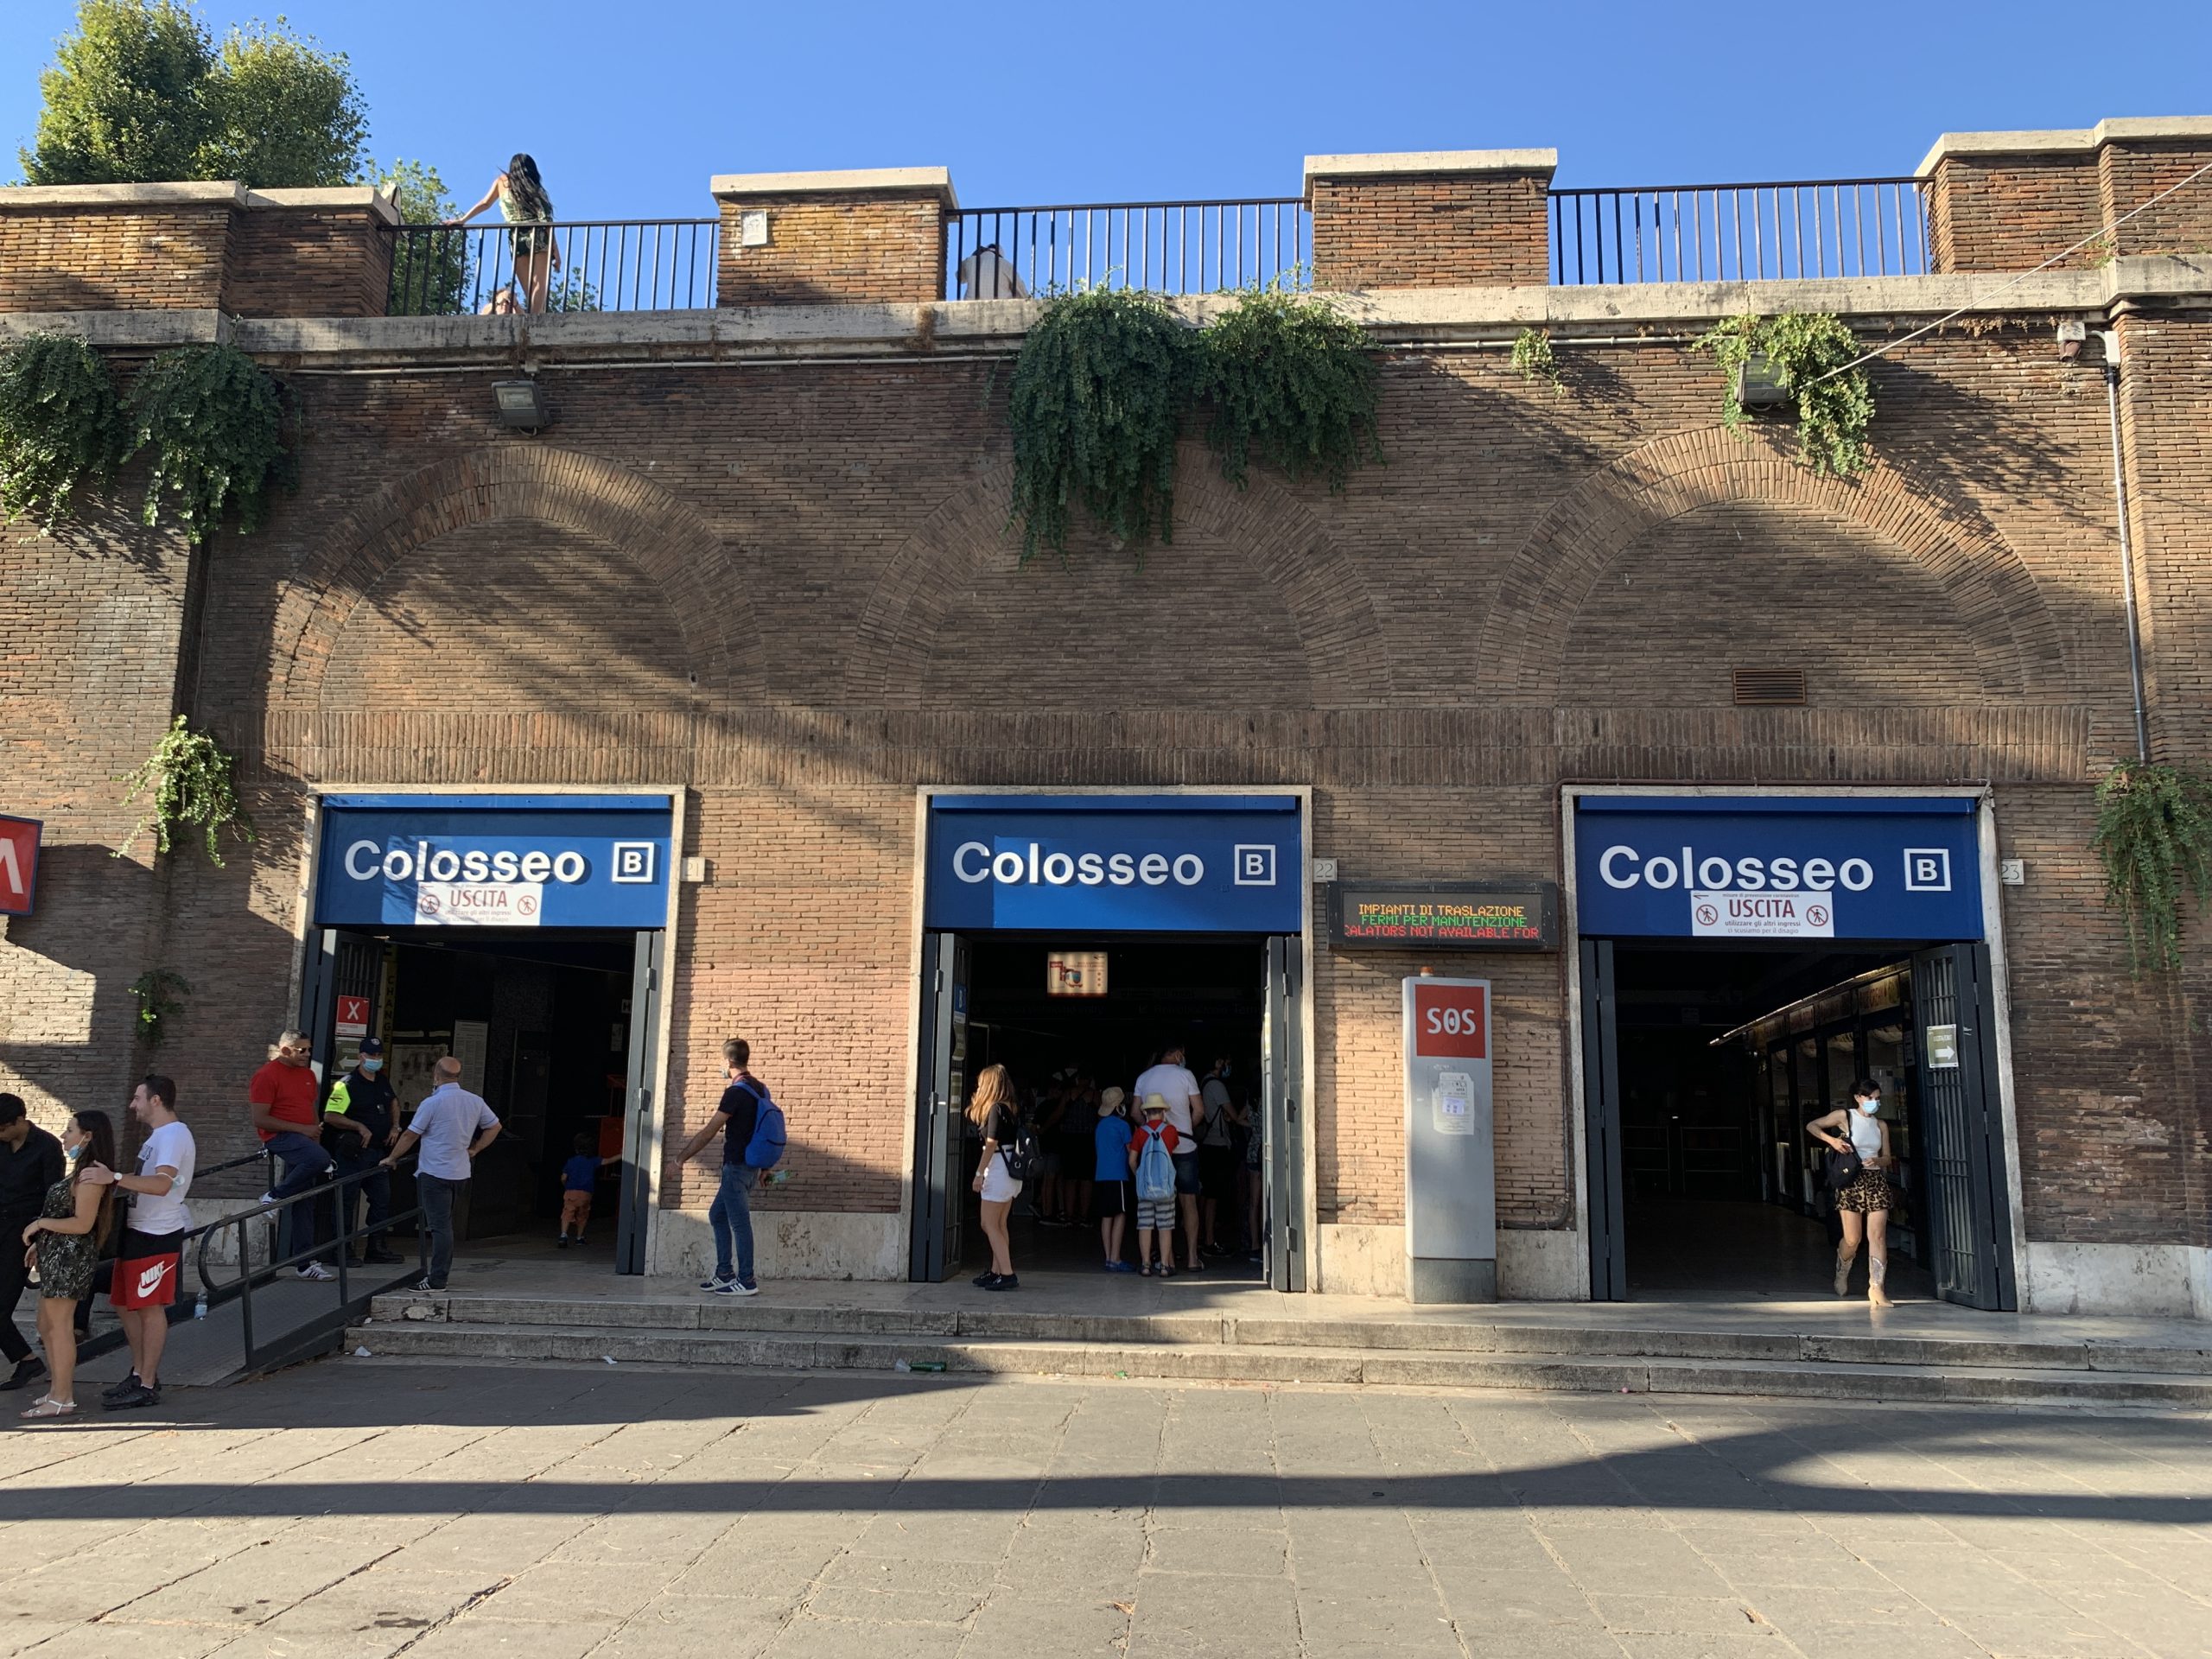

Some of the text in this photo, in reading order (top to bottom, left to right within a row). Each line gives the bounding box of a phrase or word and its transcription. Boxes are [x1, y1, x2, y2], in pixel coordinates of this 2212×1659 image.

[345, 839, 642, 882] Colosseo B
[953, 841, 1264, 886] Colosseo B
[1599, 845, 1938, 891] Colosseo B
[1316, 862, 1333, 878] 22
[2001, 864, 2019, 880] 23
[450, 890, 508, 907] USCITA
[1358, 904, 1525, 917] IMPIANTI DI TRASLAZIONE
[1729, 899, 1796, 918] USCITA
[1361, 915, 1528, 928] FERMI PER MANUTENZIONE
[1410, 925, 1434, 938] NOT
[1438, 926, 1510, 938] AVAILABLE
[1514, 926, 1539, 939] FOR
[1427, 1007, 1477, 1036] SOS
[141, 1260, 165, 1287] NIKE
